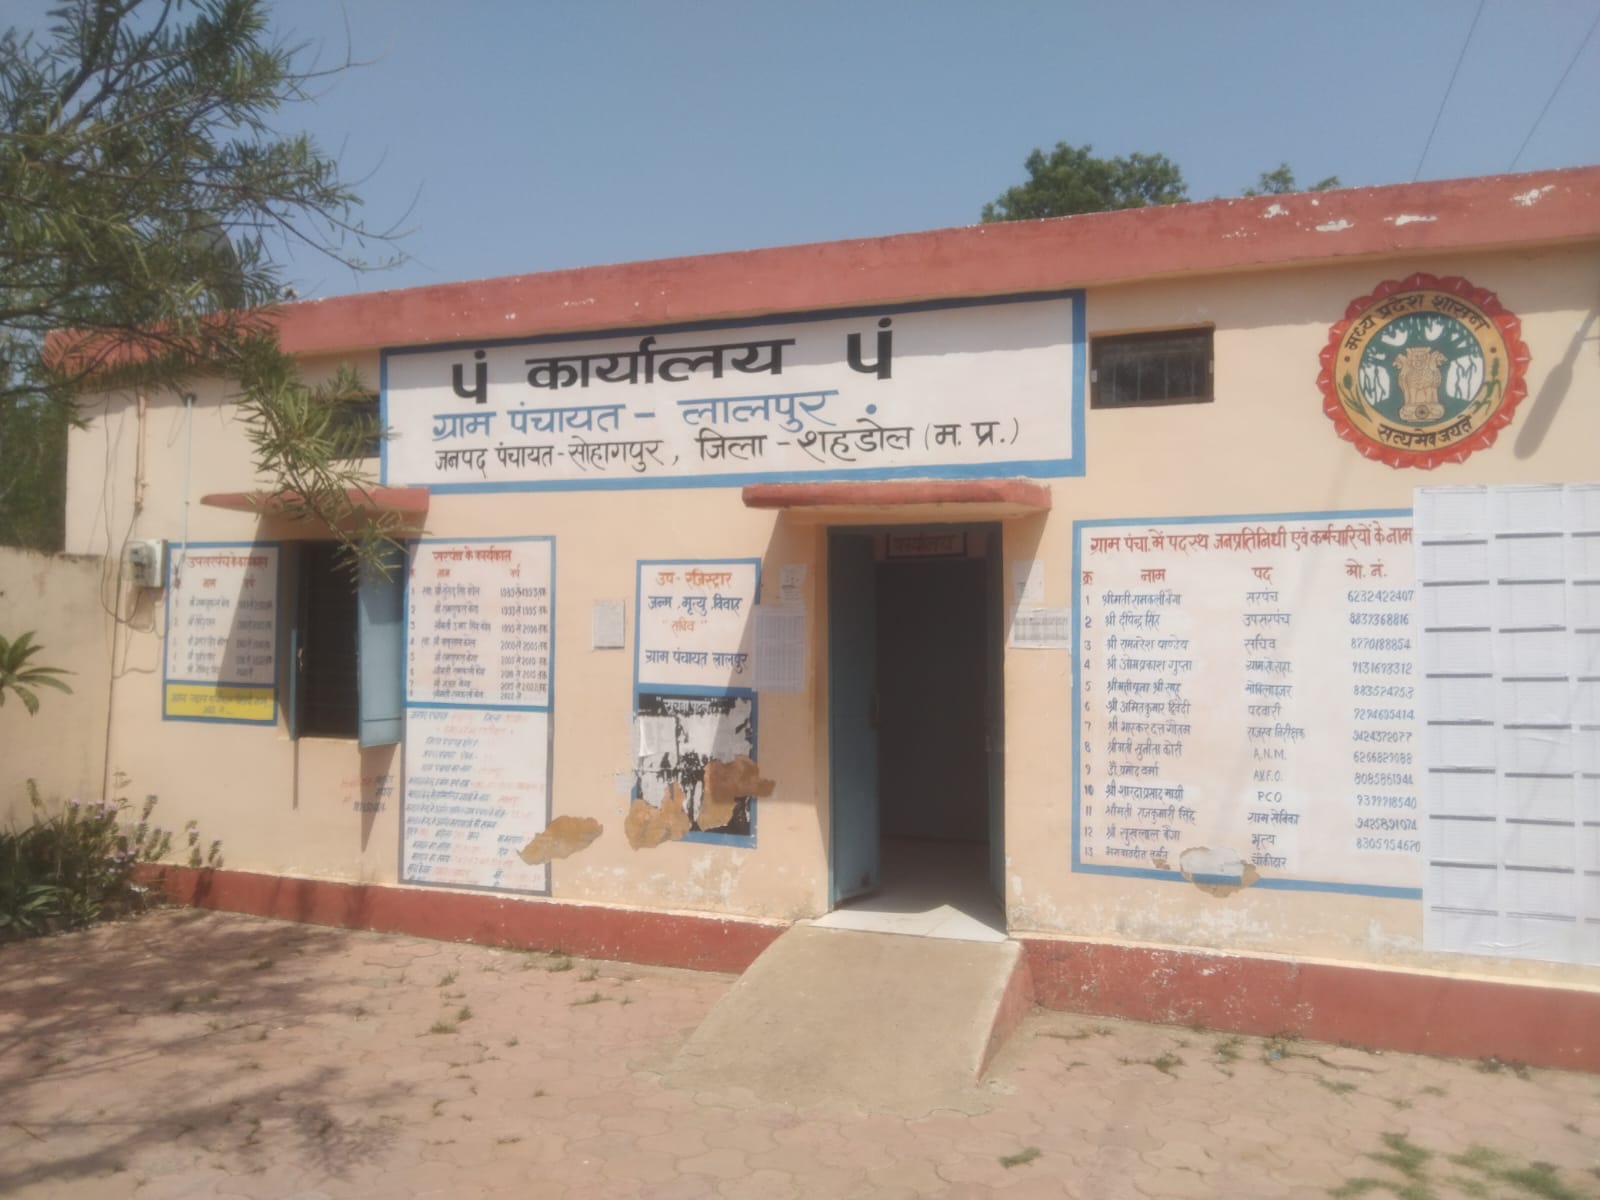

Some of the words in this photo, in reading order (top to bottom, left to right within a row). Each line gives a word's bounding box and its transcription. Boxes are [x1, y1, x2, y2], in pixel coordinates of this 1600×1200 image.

[525, 336, 795, 390] कार्यालय
[433, 411, 496, 441] ग्राम
[507, 401, 626, 435] पंचायत
[677, 390, 838, 433] लालपुर
[435, 449, 489, 478] जनपद
[695, 427, 767, 461] जिला
[1090, 537, 1121, 556] ग्राम
[1167, 534, 1209, 556] पदस्थ
[1386, 527, 1413, 545] नाम
[1141, 568, 1166, 583] नाम
[1251, 567, 1274, 584] पद
